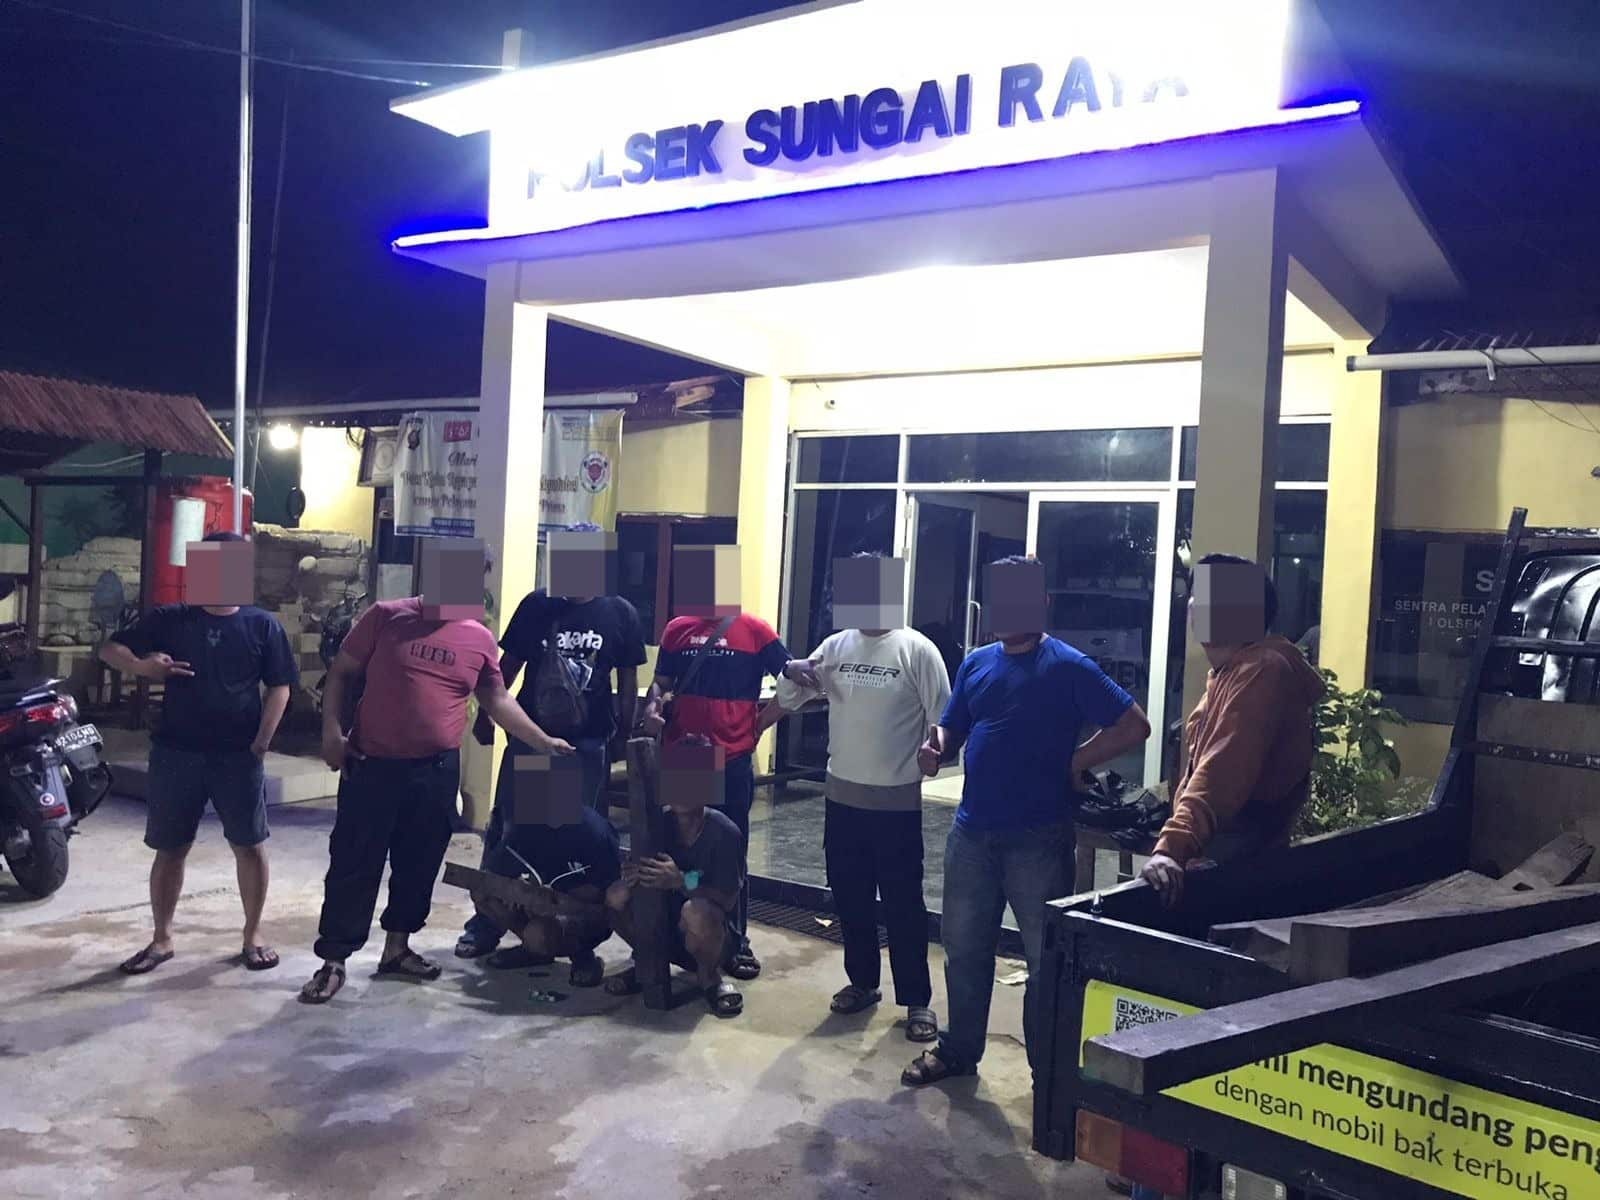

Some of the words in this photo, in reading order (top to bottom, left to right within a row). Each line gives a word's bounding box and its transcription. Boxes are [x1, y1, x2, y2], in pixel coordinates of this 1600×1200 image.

[743, 74, 973, 167] SUNGAI
[1395, 600, 1447, 613] SENTRA
[541, 630, 604, 650] akarta
[839, 663, 900, 678] EIGER
[1298, 1059, 1515, 1147] mengundang
[1215, 1075, 1303, 1121] dengan
[1313, 1108, 1384, 1147] mobil
[1395, 1128, 1443, 1166] bak
[1453, 1148, 1568, 1200] terbuka
